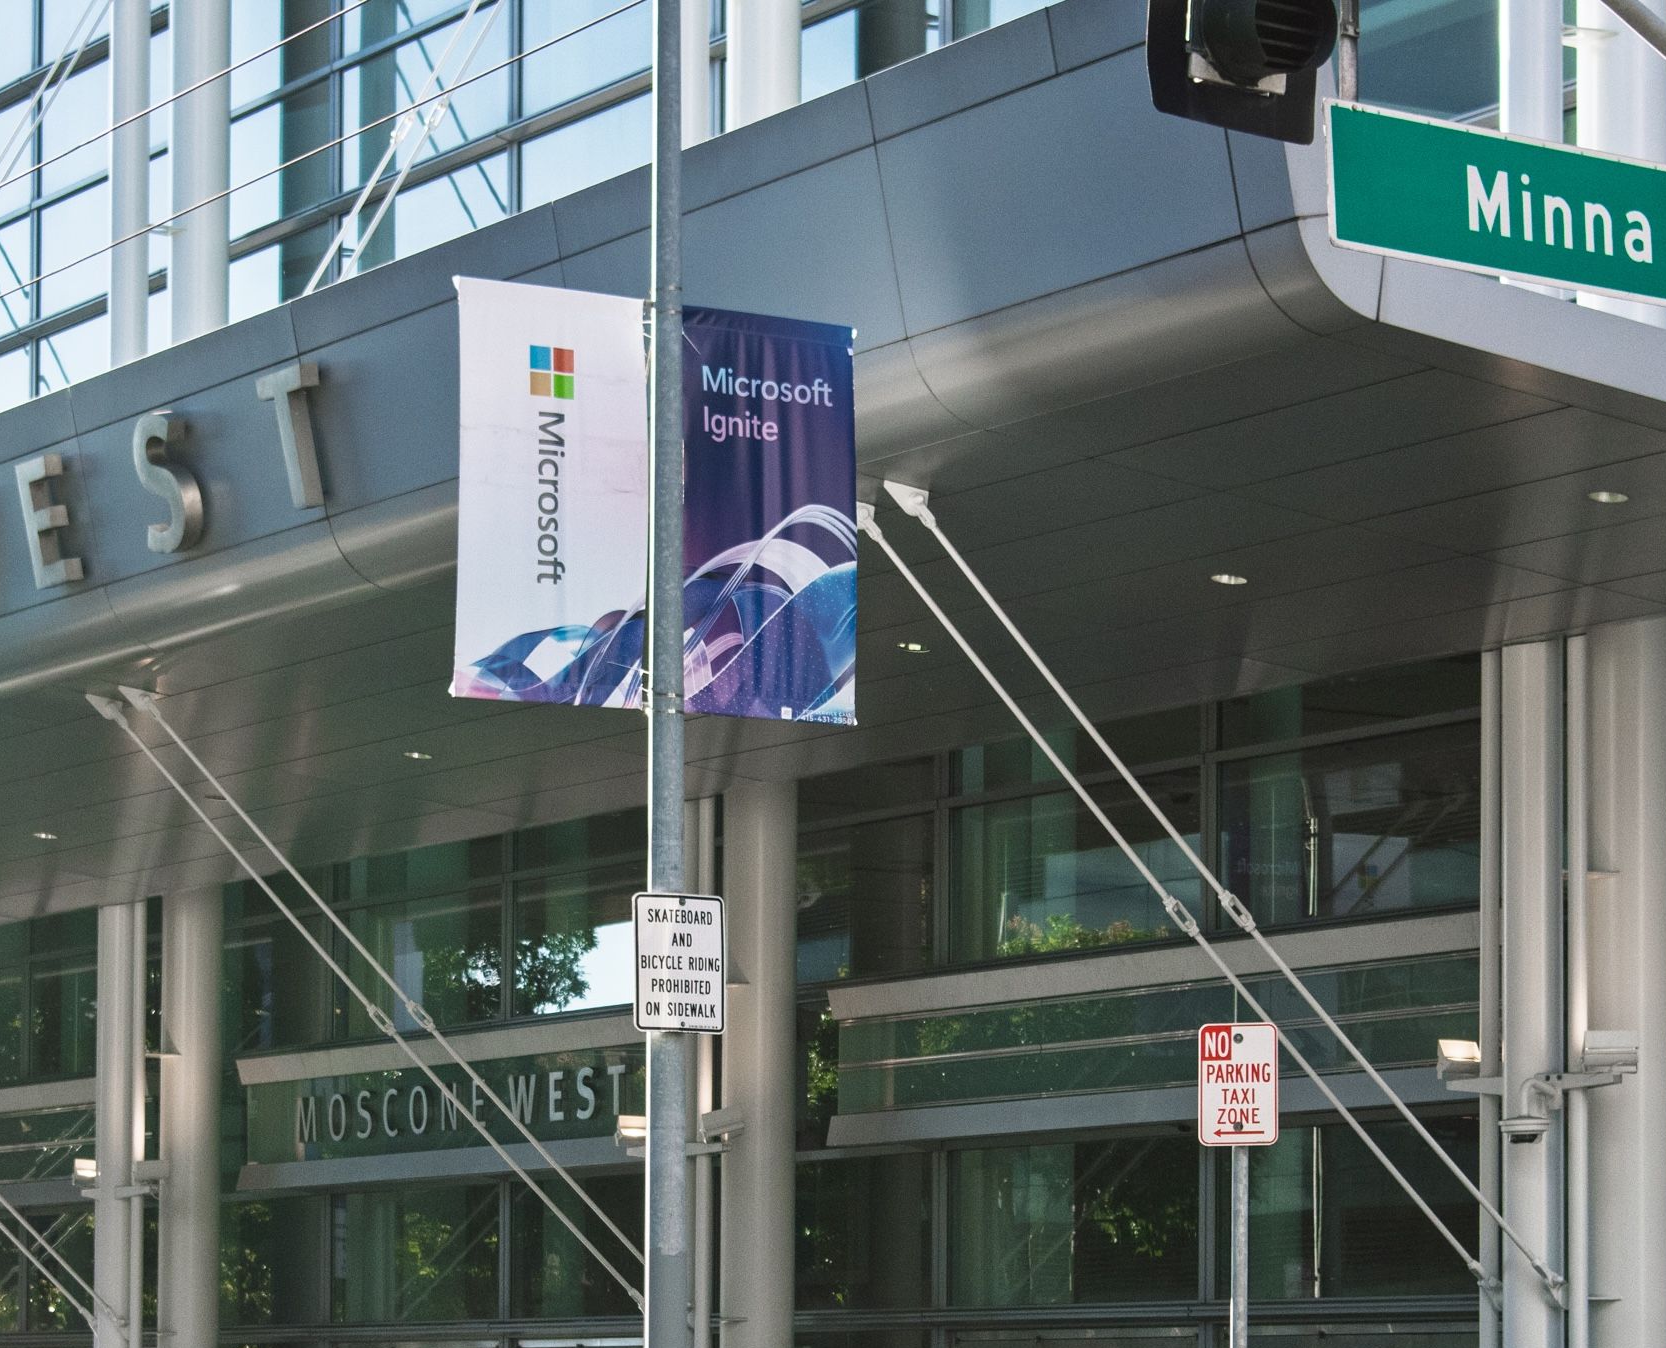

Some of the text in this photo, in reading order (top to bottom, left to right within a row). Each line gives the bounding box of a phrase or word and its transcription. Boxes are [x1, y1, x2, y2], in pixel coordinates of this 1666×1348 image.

[1466, 164, 1654, 264] Minna
[701, 365, 834, 409] Microsoft
[703, 406, 779, 443] Ignite
[537, 411, 566, 585] Microsoft
[647, 908, 713, 926] SKATEBOARD
[671, 933, 693, 947] AND
[641, 955, 721, 972] BICYCLE RIDING
[651, 978, 711, 995] PROHIBITED
[646, 1001, 716, 1019] ON SIDEWALK
[1204, 1031, 1230, 1058] NO
[1206, 1063, 1271, 1084] PARKING
[294, 1064, 628, 1144] MOSCONE WEST
[1221, 1088, 1256, 1105] TAXI
[1217, 1108, 1261, 1125] ZONE
